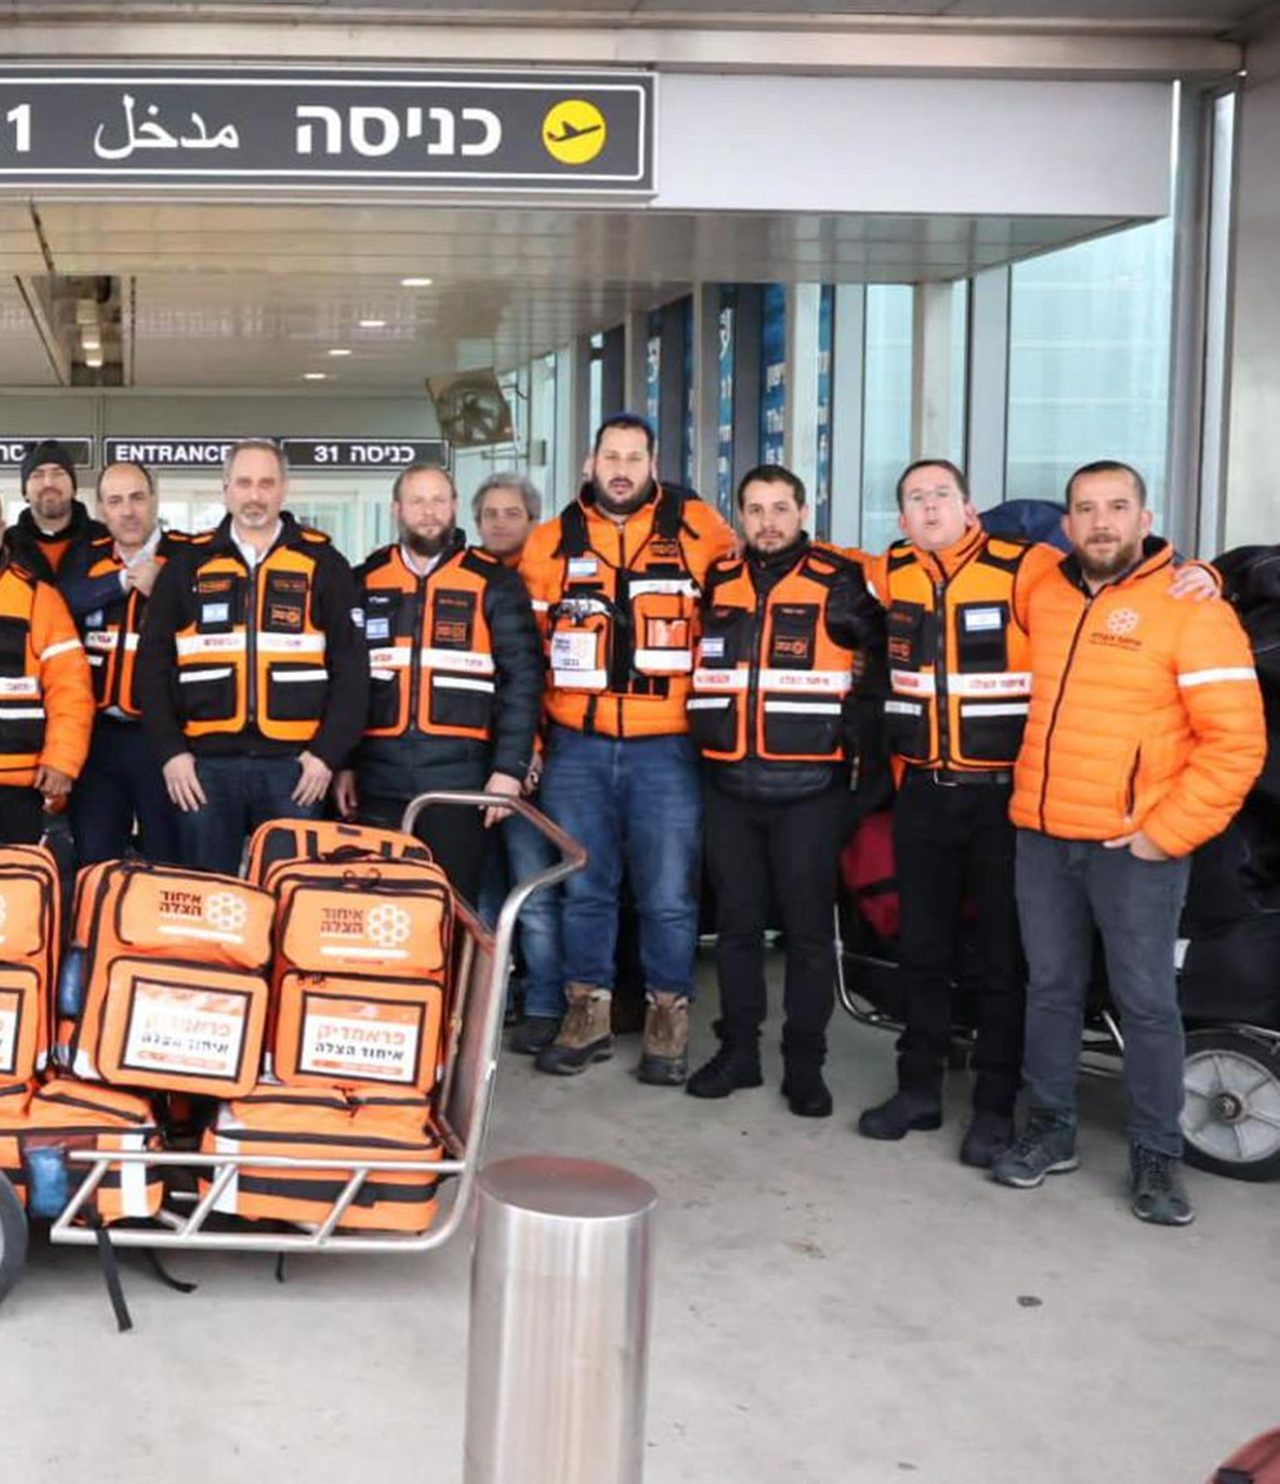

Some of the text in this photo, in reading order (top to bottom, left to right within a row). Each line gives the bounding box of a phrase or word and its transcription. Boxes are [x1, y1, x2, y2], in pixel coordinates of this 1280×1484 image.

[92, 93, 240, 160] مدخل
[295, 105, 503, 157] כניסה
[313, 445, 416, 463] כניסה 31
[159, 890, 202, 904] איחוד
[159, 901, 202, 917] הצלה
[321, 907, 364, 920] איחוד
[320, 920, 364, 934] הצלה
[315, 1041, 404, 1060] איחוד הצלה
